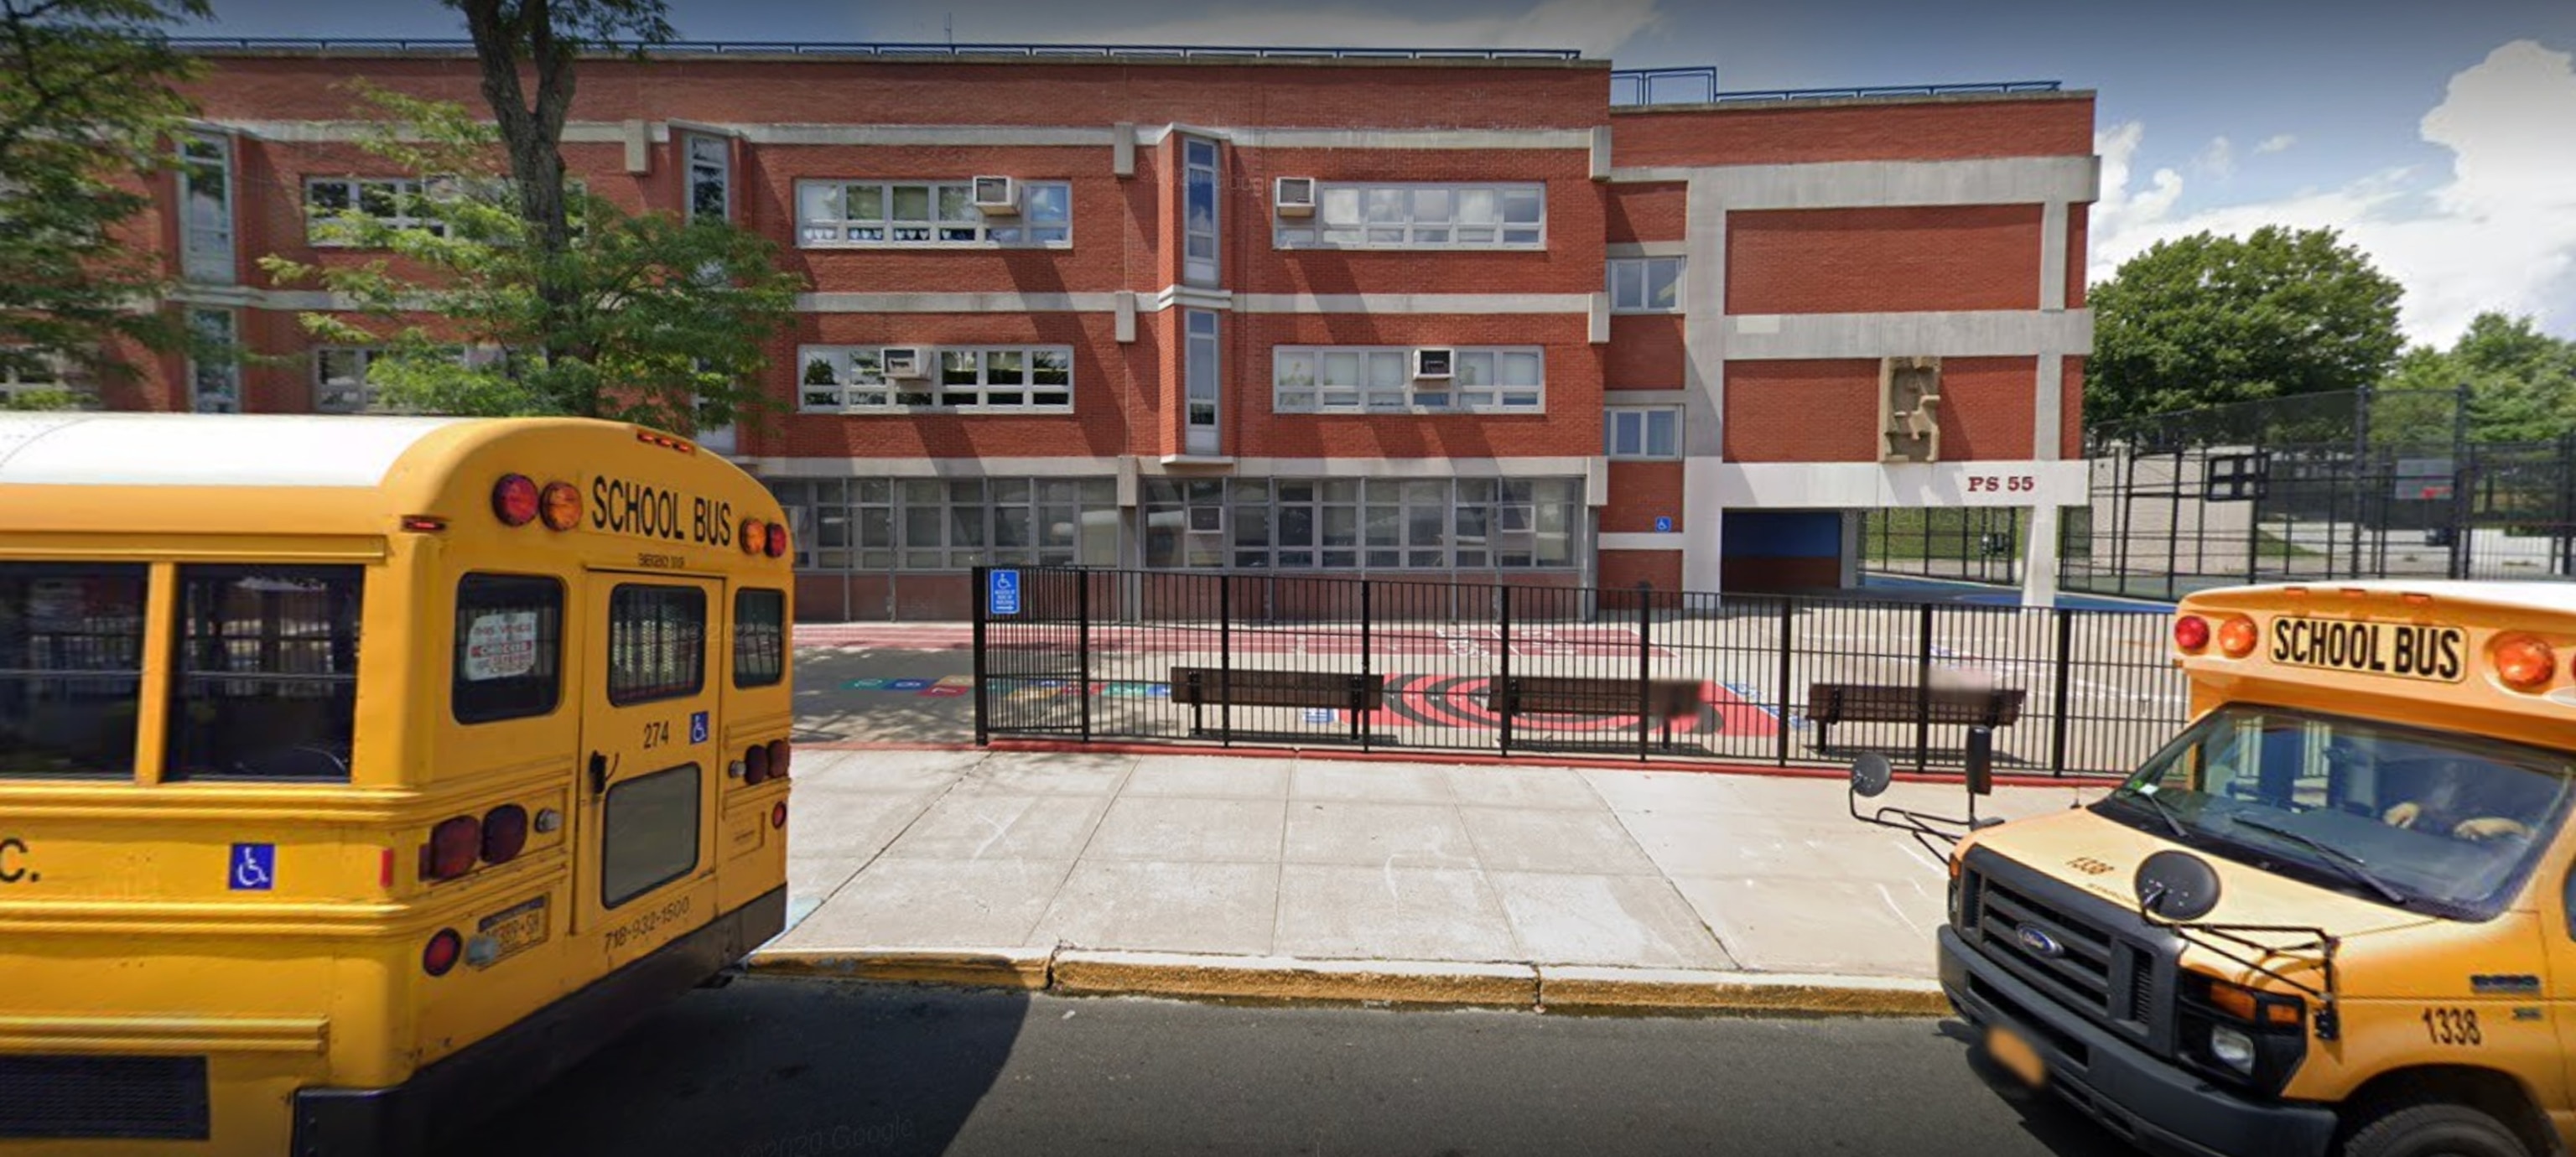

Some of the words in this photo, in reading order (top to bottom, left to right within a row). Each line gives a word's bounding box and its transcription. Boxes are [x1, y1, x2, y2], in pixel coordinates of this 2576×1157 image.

[1968, 476, 2000, 492] PS
[2007, 476, 2034, 492] 55
[592, 475, 684, 541] SCHOOL
[693, 496, 731, 547] BUS
[2273, 619, 2386, 672] SCHOOL
[2394, 626, 2461, 680] BUS
[644, 721, 669, 750] 274
[605, 895, 690, 954] 718-932-1500
[2423, 1008, 2482, 1045] 1338
